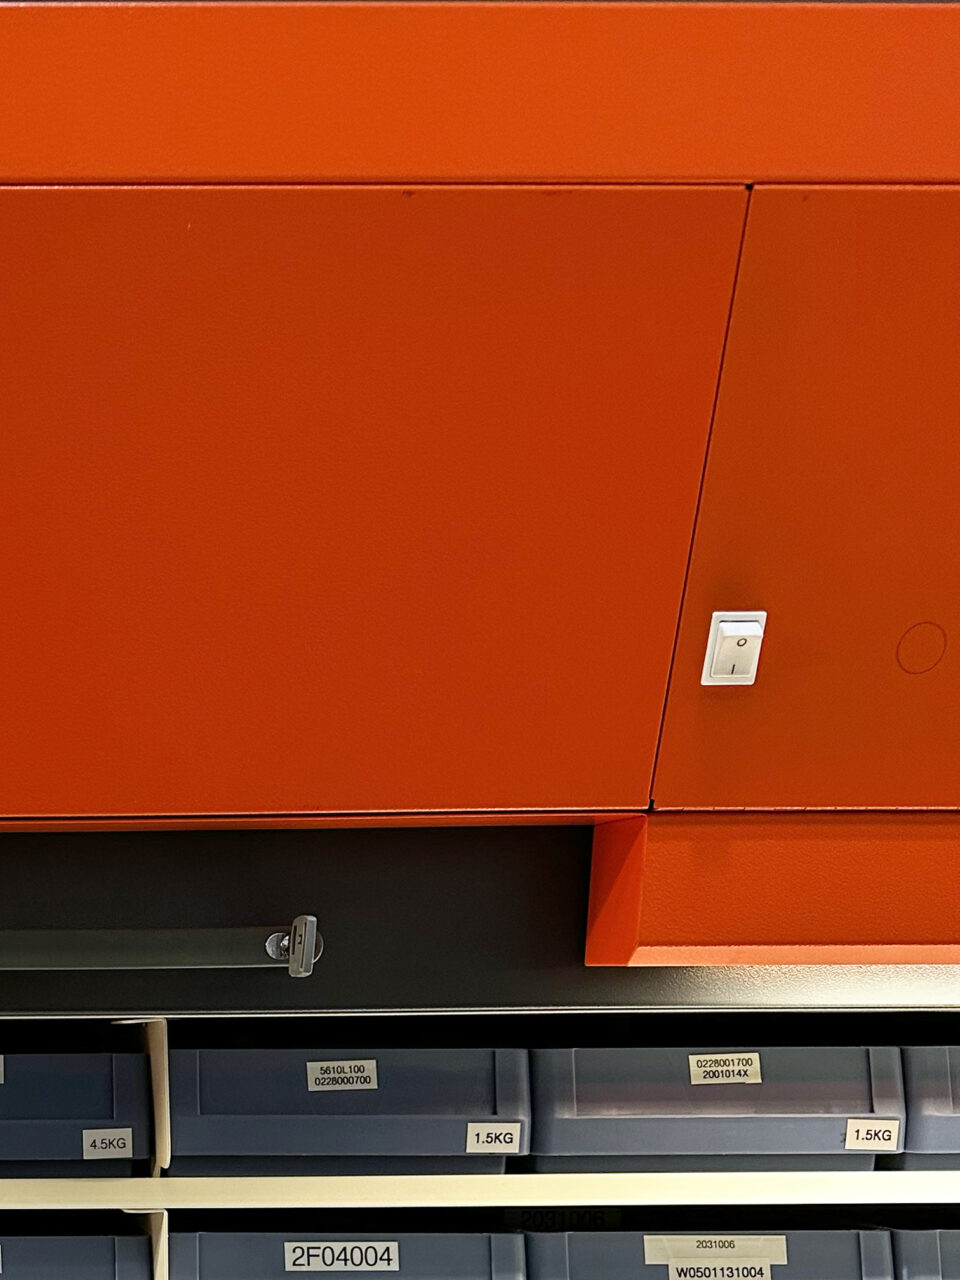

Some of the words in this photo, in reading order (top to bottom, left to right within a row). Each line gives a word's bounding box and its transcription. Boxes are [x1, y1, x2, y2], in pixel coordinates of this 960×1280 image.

[695, 1057, 754, 1069] 0228001700
[319, 1064, 366, 1076] 5610L100
[702, 1068, 750, 1080] 2001014X
[314, 1075, 372, 1087] 0228000700
[474, 1132, 514, 1145] 1.5KG
[854, 1128, 892, 1142] 1.5KG
[89, 1137, 127, 1150] 4.5KG
[695, 1239, 736, 1249] 2031006
[292, 1245, 393, 1267] 2F04004
[675, 1266, 765, 1279] W0501131004
